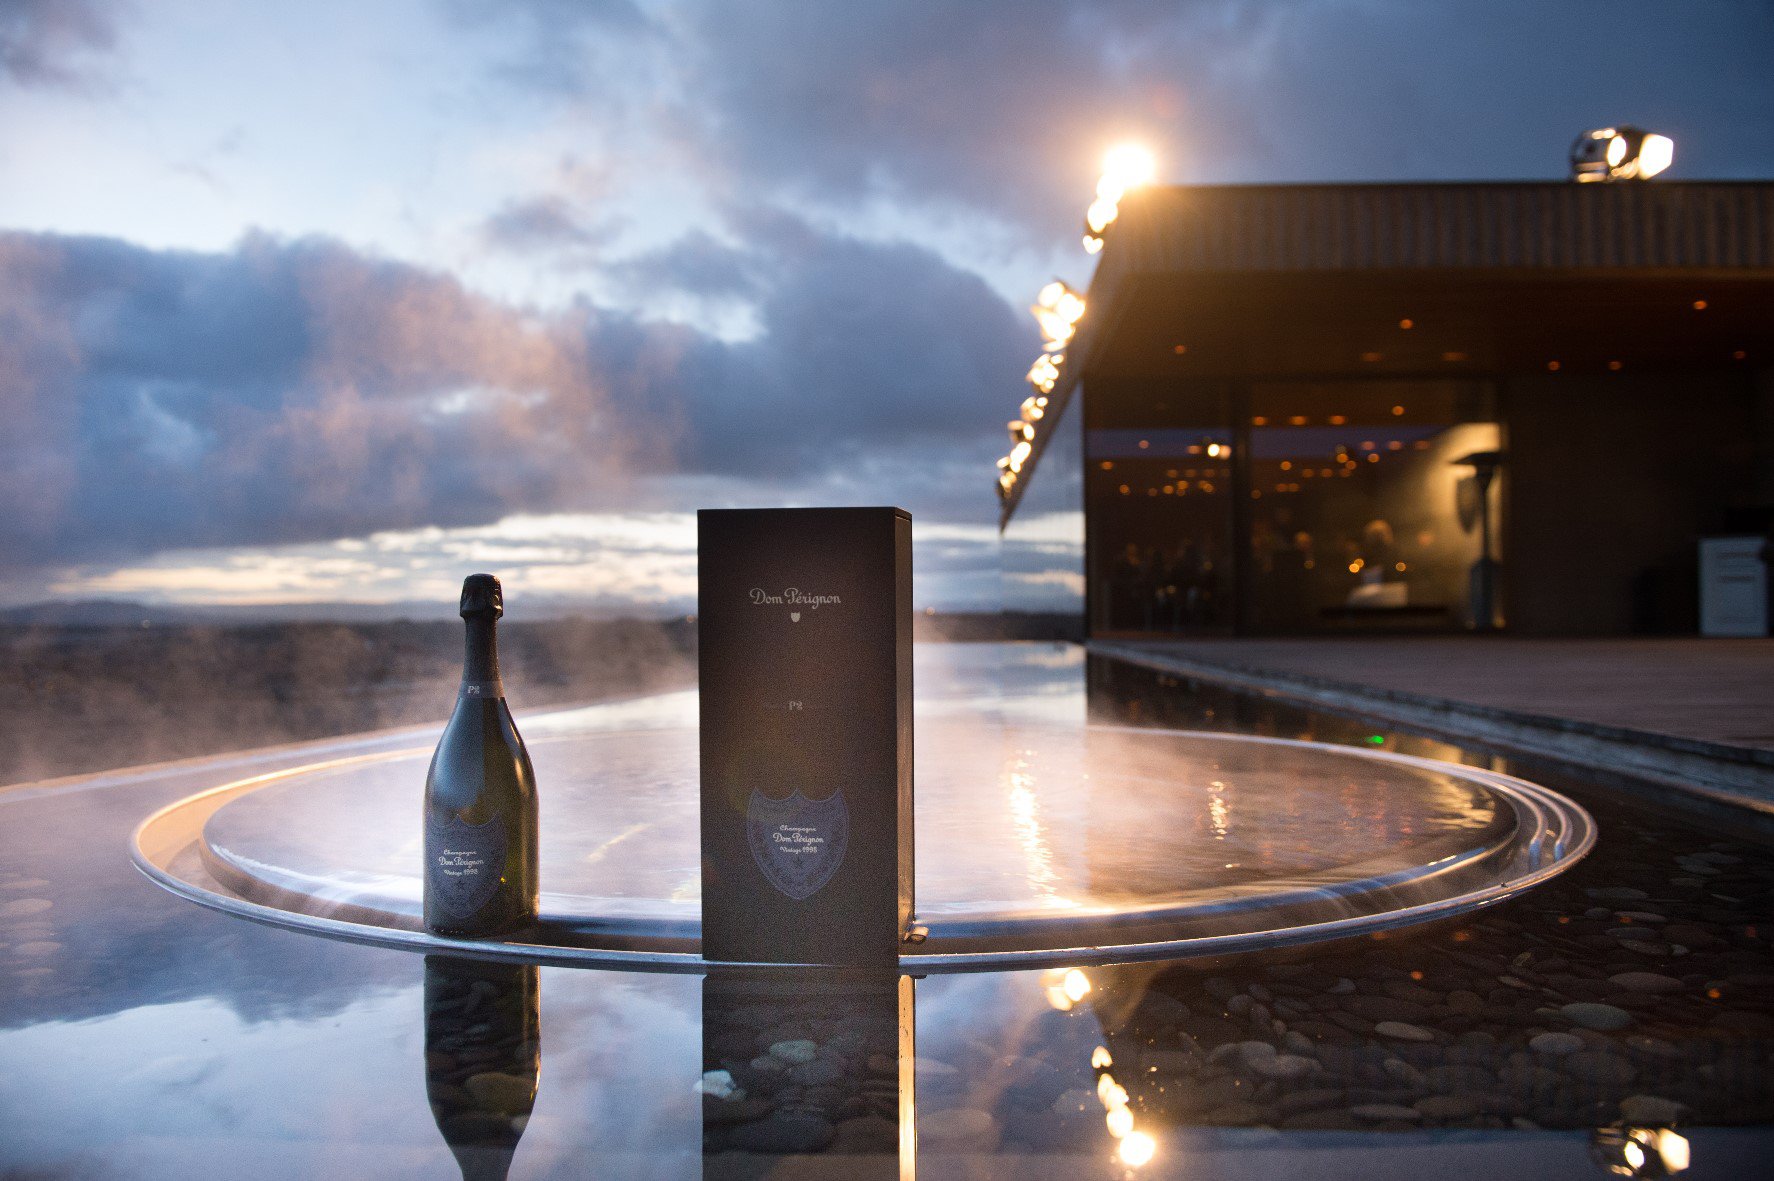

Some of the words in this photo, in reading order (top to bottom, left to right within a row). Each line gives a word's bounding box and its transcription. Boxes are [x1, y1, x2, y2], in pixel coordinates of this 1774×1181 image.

[749, 587, 783, 605] Dom
[784, 587, 841, 610] Pérignon
[772, 832, 792, 843] Dom
[791, 832, 824, 846] Pérignon
[438, 855, 454, 866] Dom
